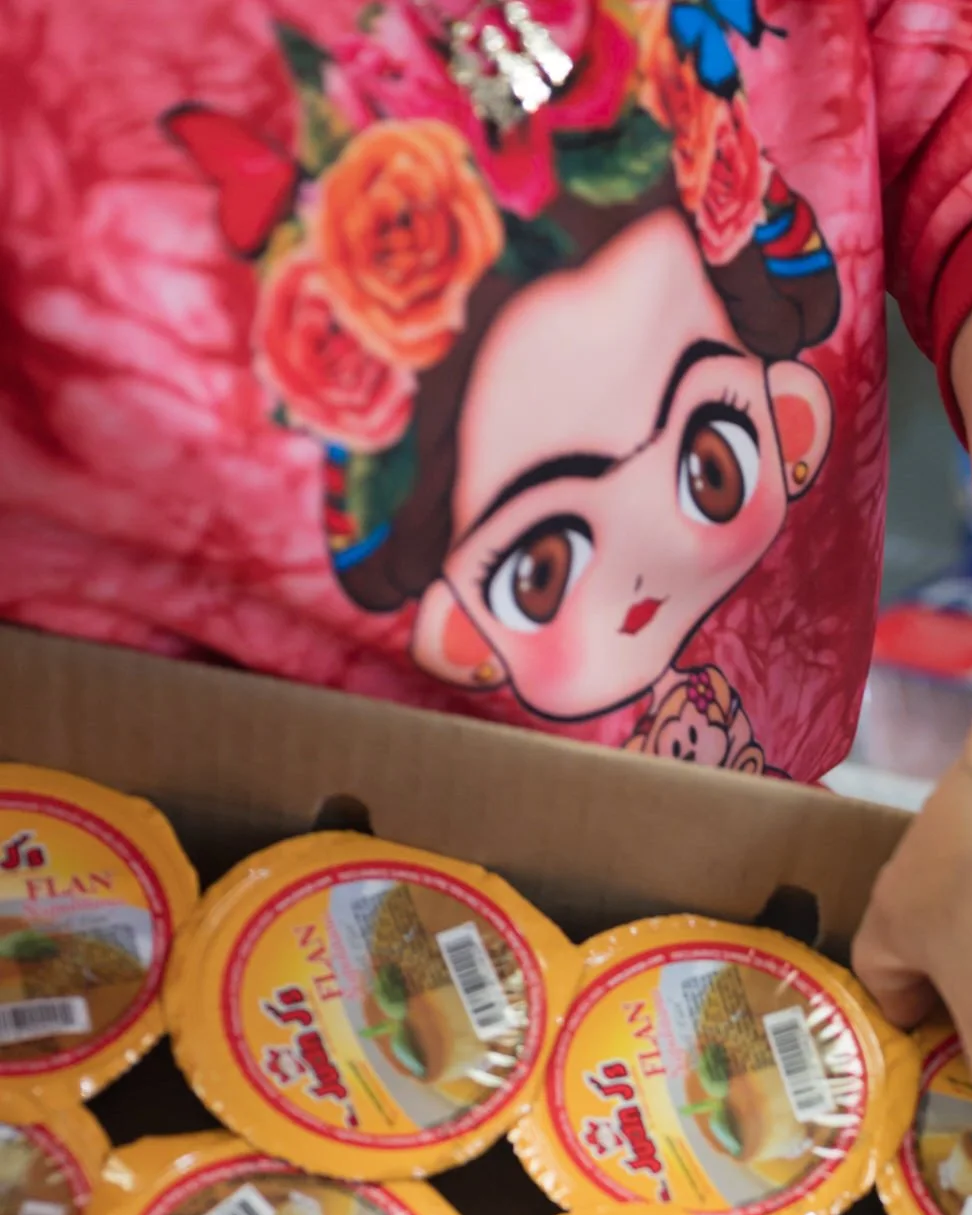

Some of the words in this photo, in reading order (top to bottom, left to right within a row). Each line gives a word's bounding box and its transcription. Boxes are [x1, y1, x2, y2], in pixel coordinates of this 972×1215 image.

[26, 872, 113, 901] FLAN
[293, 924, 343, 1002] FLAN
[298, 1031, 347, 1099] Juan
[622, 1001, 666, 1078] FLAN
[618, 1105, 662, 1173] Juan
